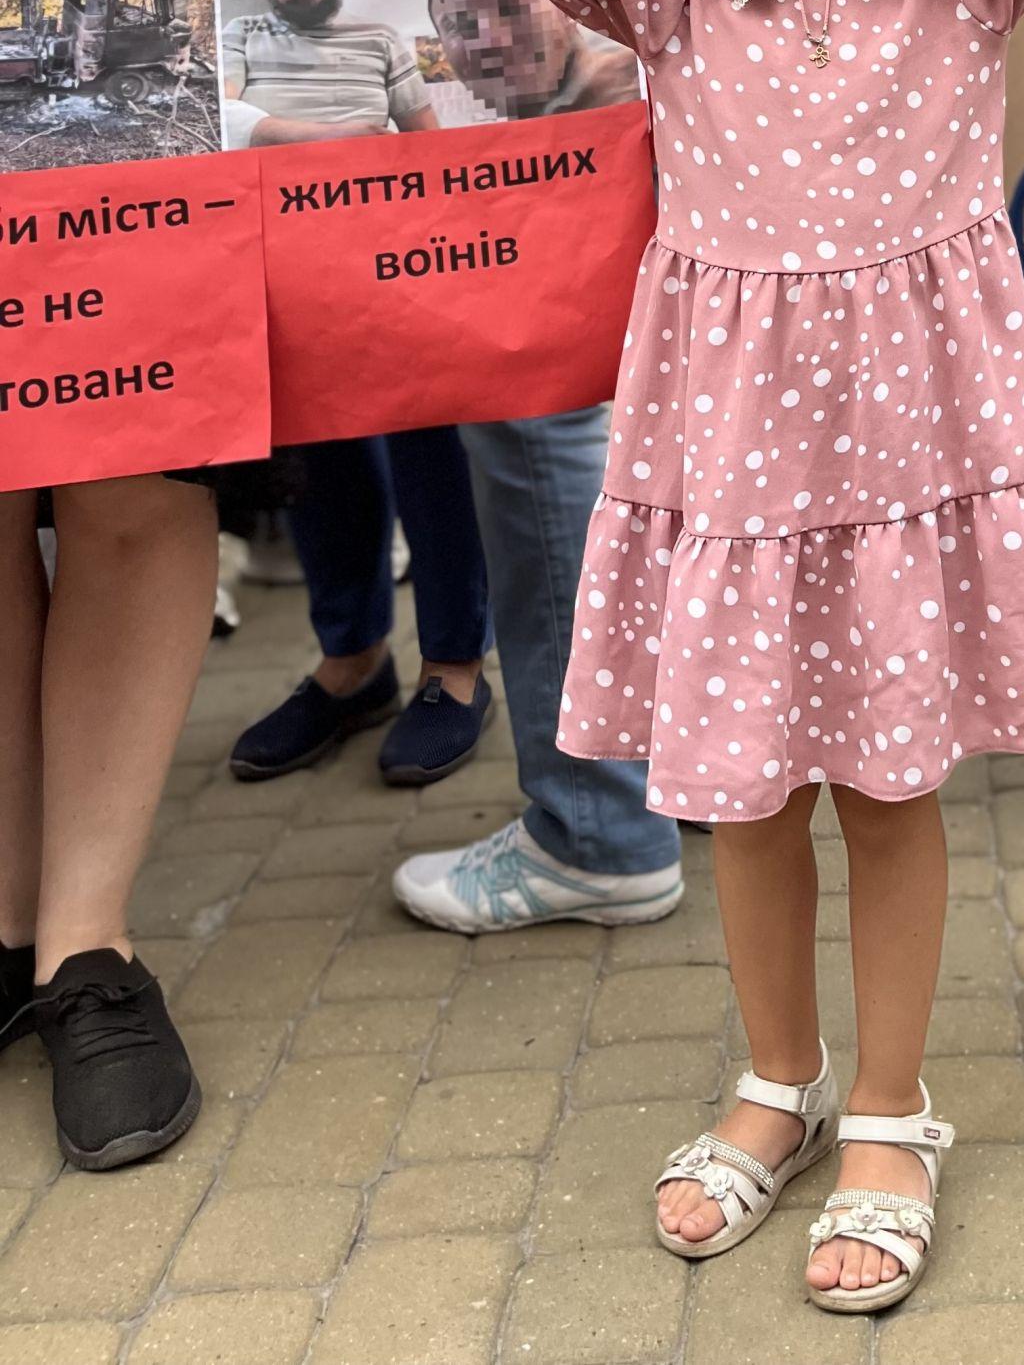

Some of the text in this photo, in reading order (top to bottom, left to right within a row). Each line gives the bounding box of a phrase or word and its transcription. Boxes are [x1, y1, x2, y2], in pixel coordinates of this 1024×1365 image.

[279, 146, 598, 214] життя наших
[57, 196, 190, 240] міста
[375, 230, 519, 281] воїнів
[44, 289, 104, 323] не
